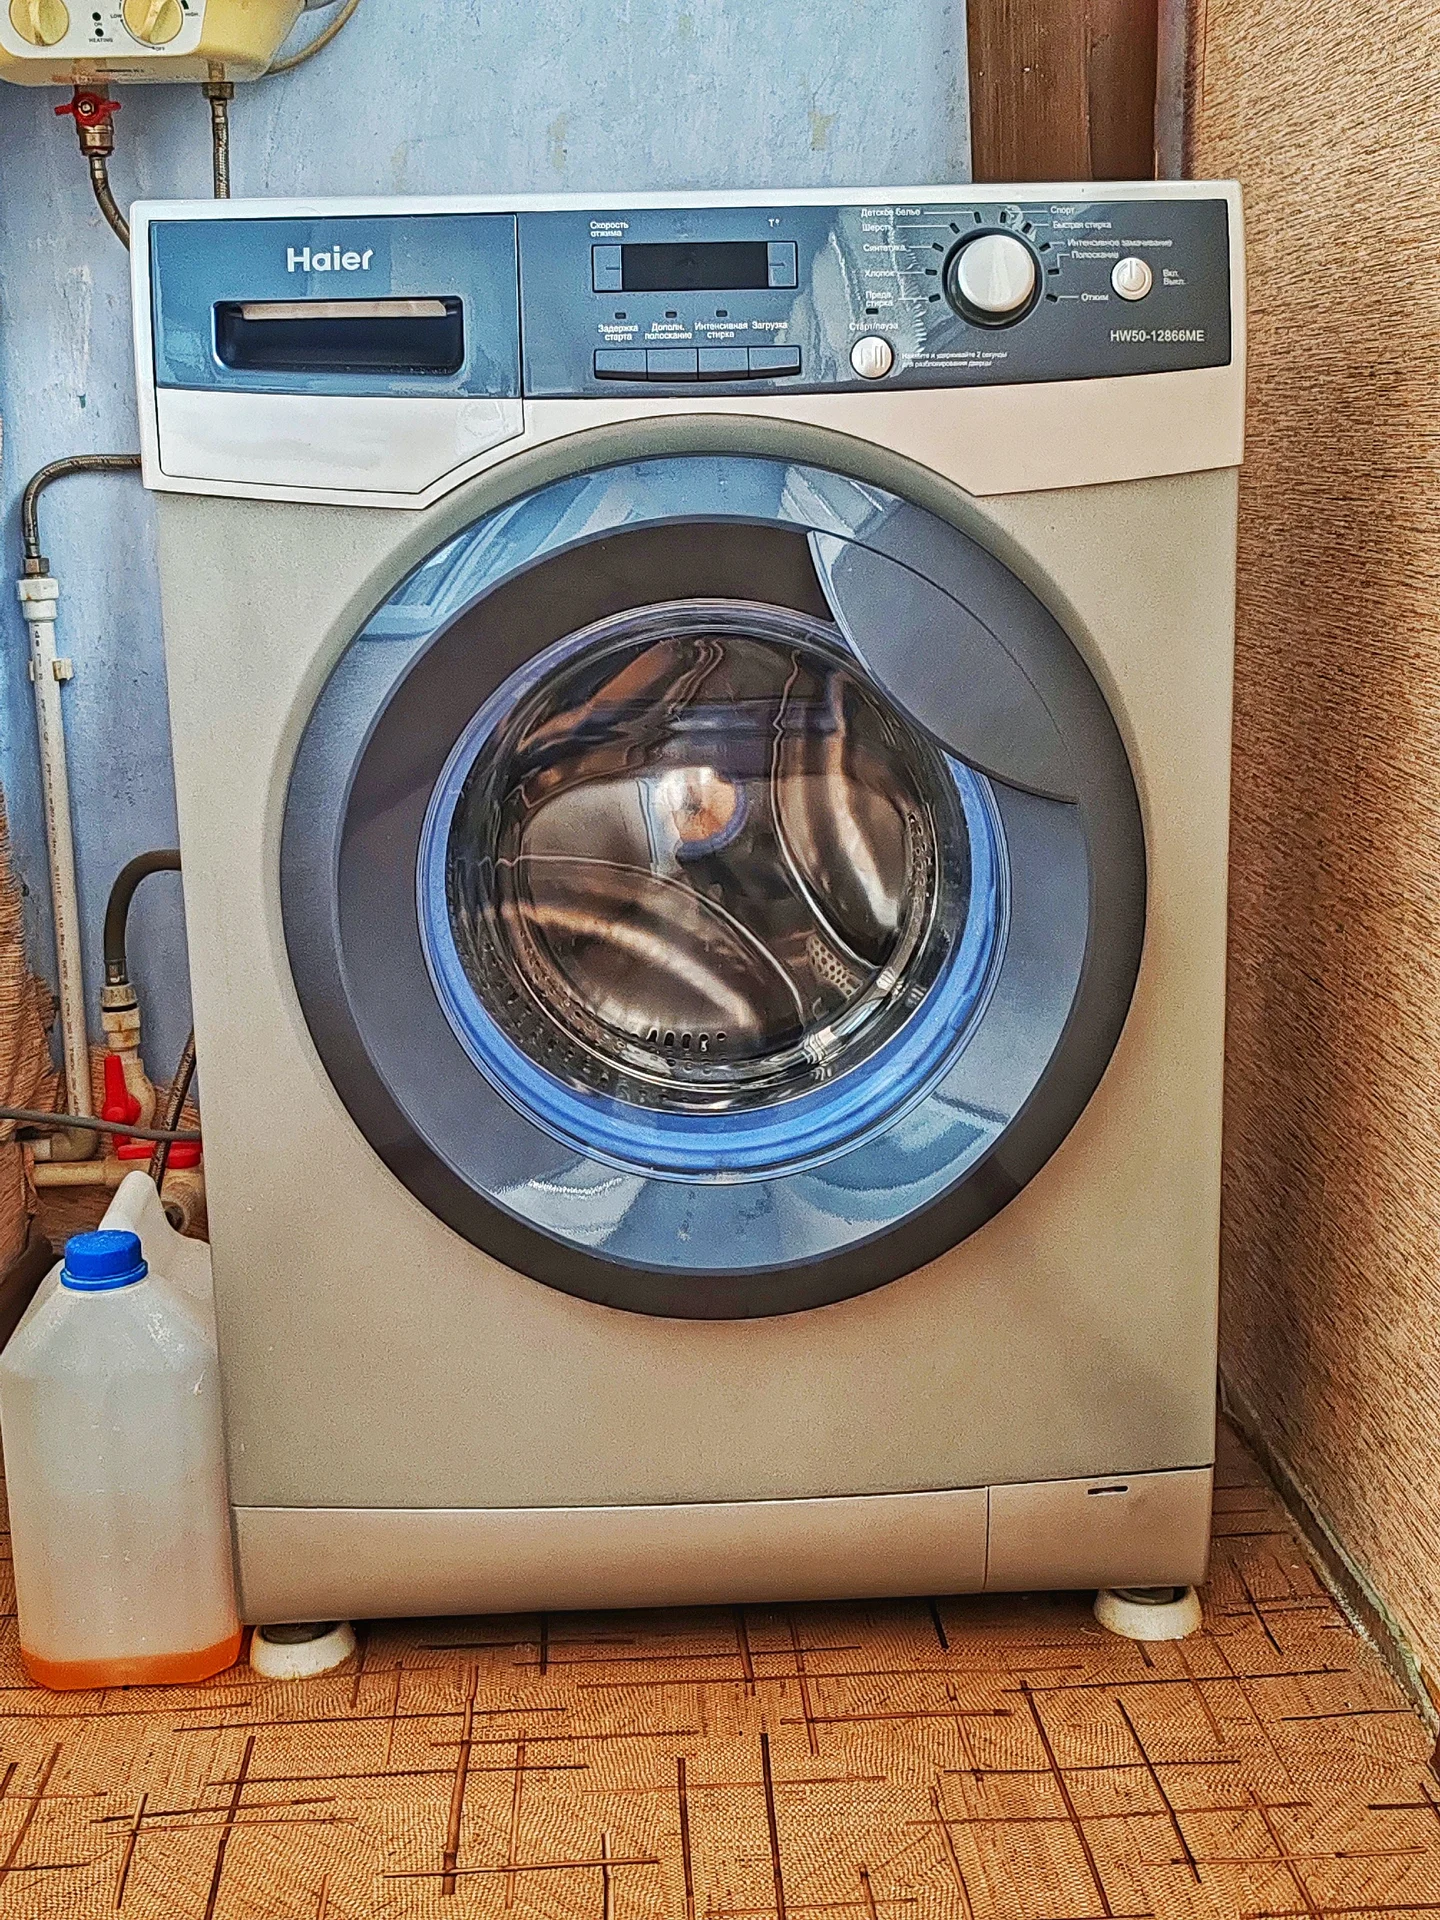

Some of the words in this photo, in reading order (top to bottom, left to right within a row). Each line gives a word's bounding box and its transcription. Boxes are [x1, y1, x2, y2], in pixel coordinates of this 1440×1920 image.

[861, 208, 893, 218] Детское
[895, 207, 921, 216] белье
[1050, 205, 1075, 215] Спорт
[590, 220, 629, 230] Скорость
[862, 223, 894, 232] Шерсть
[1052, 221, 1084, 230] Быстрая
[1085, 222, 1112, 230] стирка
[590, 230, 622, 238] отжима
[1067, 239, 1120, 247] Интенсивное
[286, 245, 374, 273] Haier
[1071, 250, 1119, 259] Полоскание
[864, 270, 898, 278] Хлопок
[1080, 293, 1109, 302] Отжим
[865, 300, 893, 309] стирка
[598, 323, 639, 333] Задержка
[651, 322, 685, 333] Дополн.
[694, 321, 748, 330] Интенсивная
[751, 320, 788, 330] Загрузка
[849, 321, 899, 332] Старт/пауза
[604, 332, 632, 342] старта
[644, 331, 692, 340] полоскание
[707, 331, 735, 340] стирка
[1110, 329, 1205, 342] HW50-12866ME
